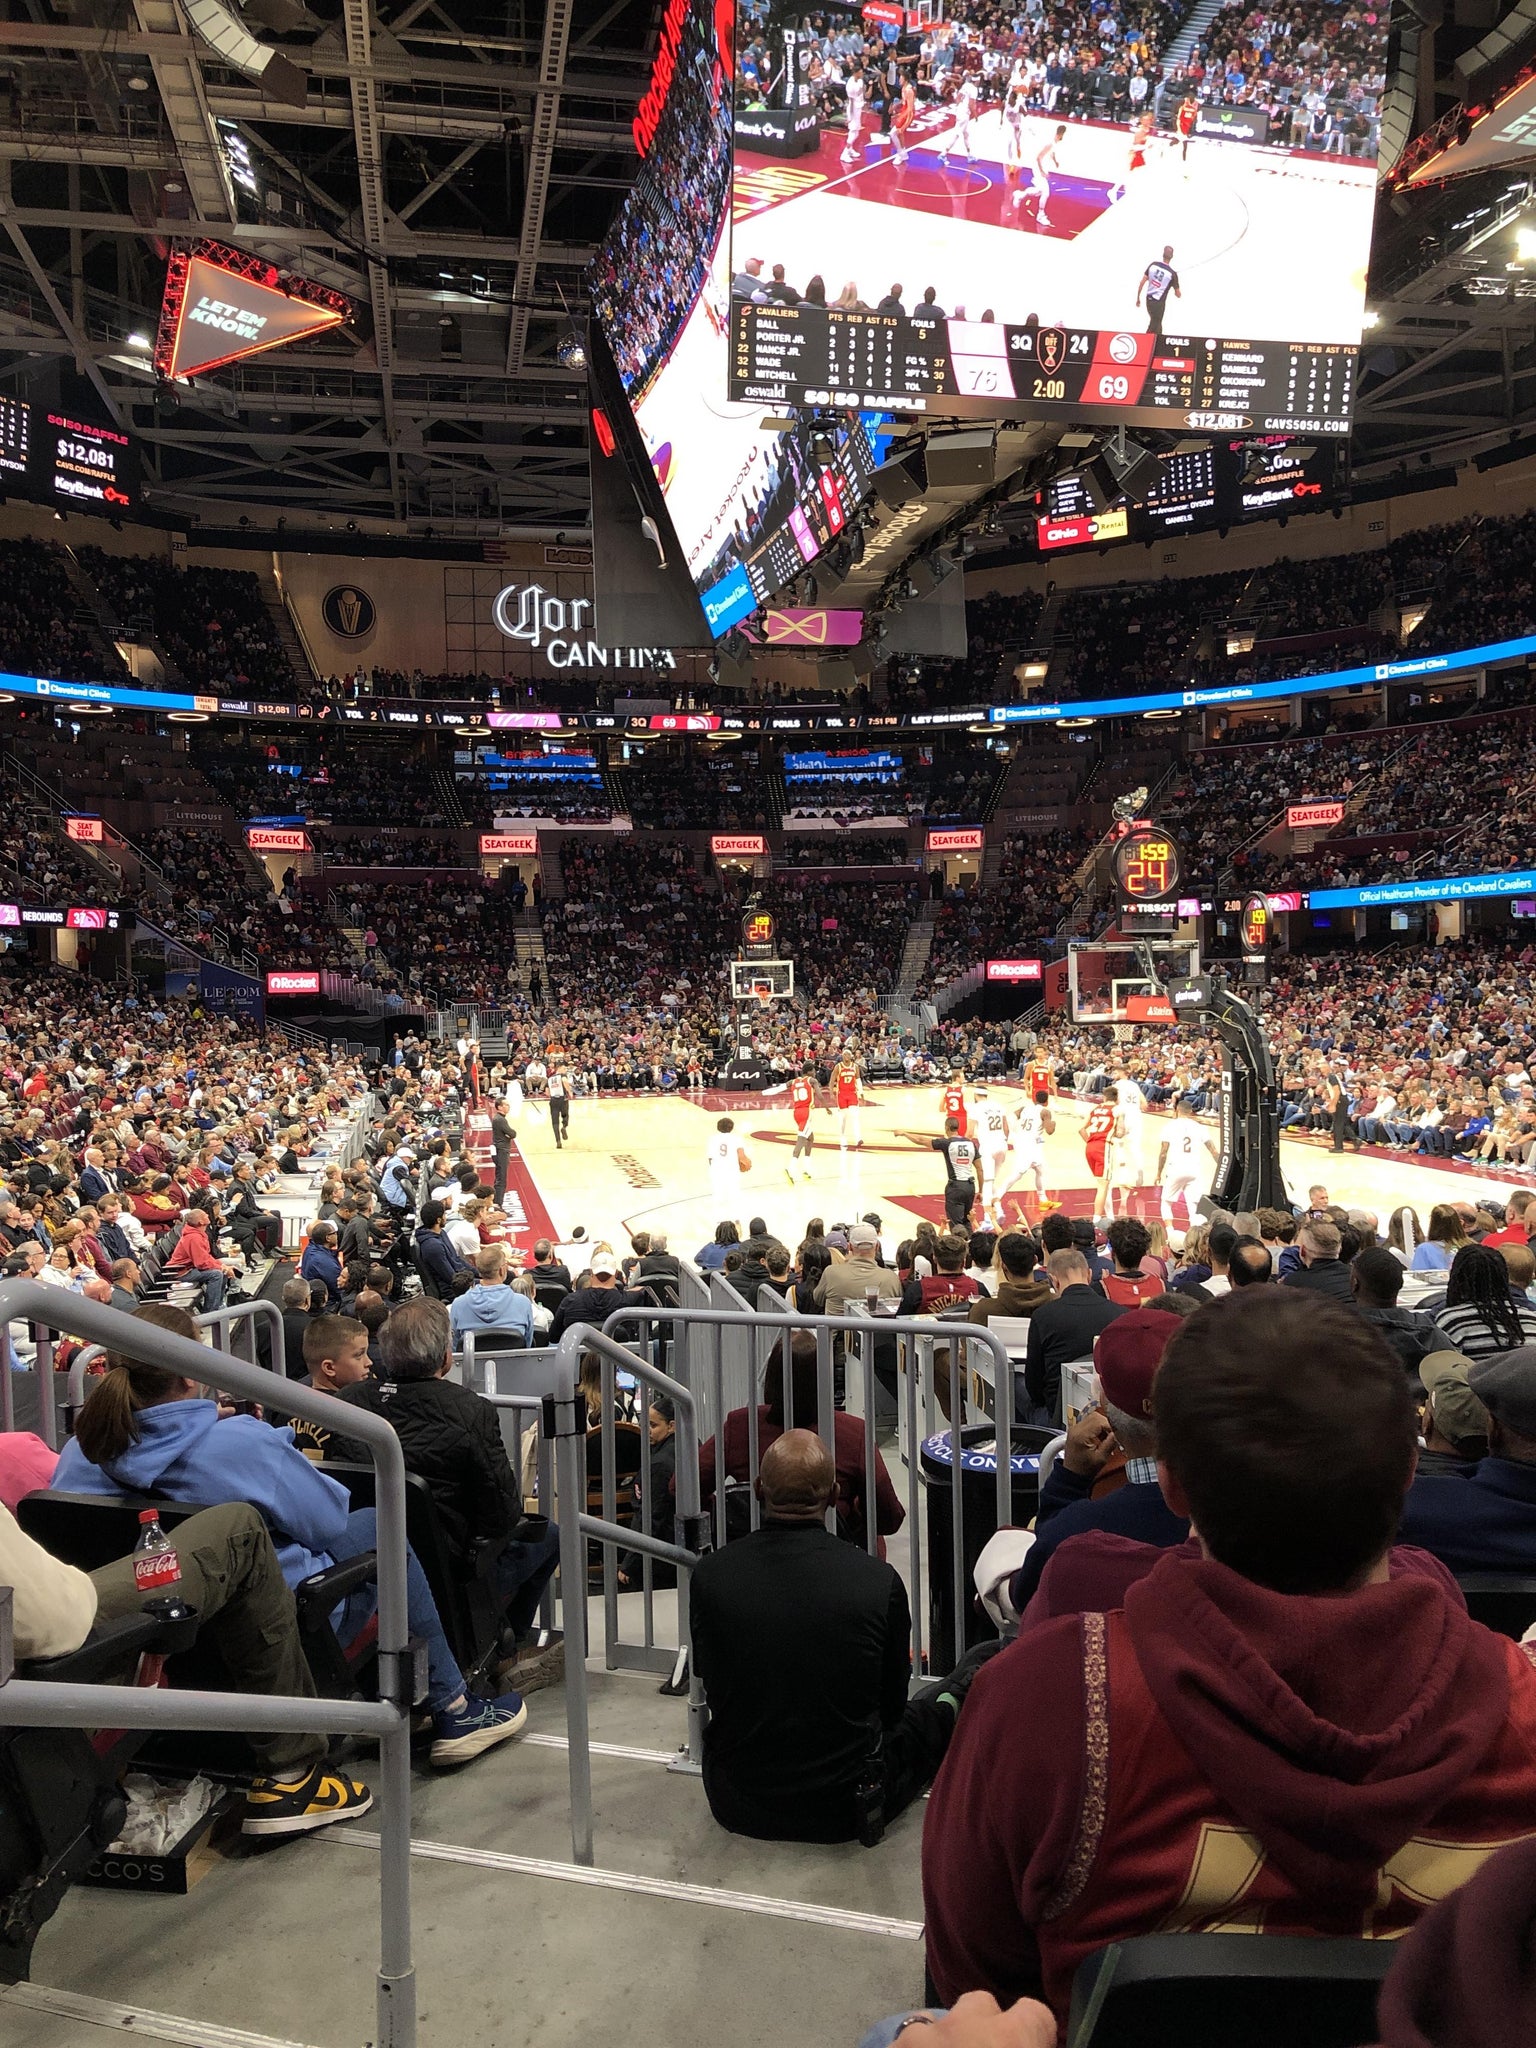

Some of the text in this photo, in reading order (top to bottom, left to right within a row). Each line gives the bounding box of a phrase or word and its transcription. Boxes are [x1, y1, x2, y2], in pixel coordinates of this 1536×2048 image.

[639, 32, 676, 141] Rocket
[198, 296, 268, 328] LET EM
[756, 307, 897, 326] CAVALIERS PTS REB AST FLS
[188, 307, 260, 341] KNOW.
[740, 319, 893, 340] 2 BALL 3 2
[911, 320, 936, 329] FOULS
[740, 331, 874, 350] 9 PORTER JR. 2 3 3
[918, 329, 926, 340] 5
[1010, 335, 1032, 351] 3Q
[1070, 335, 1089, 354] 24
[1165, 338, 1190, 346] FOULS
[1223, 341, 1250, 350] HAWKS
[1325, 346, 1340, 354] AST
[1343, 347, 1358, 355] FLS
[737, 344, 874, 363] 22 NANCE JR. 3 4 4
[1206, 352, 1213, 361] 3
[737, 356, 892, 377] 32 WADE 11 2
[933, 358, 945, 367] 37
[1206, 364, 1212, 373] 5
[737, 369, 797, 381] 45 MITCHELL
[933, 371, 944, 380] 30
[969, 370, 997, 392] 76
[1180, 375, 1192, 384] 44
[1203, 376, 1214, 384] 17
[744, 383, 787, 399] oswald
[905, 382, 943, 394] TOL 2
[1033, 379, 1065, 398] 2:00
[1099, 375, 1128, 399] 69
[1180, 388, 1191, 396] 23
[1203, 388, 1249, 398] 18 GUEYE
[863, 395, 926, 410] RAFFLE
[1154, 397, 1191, 407] TOL 2
[1201, 399, 1212, 408] 27
[1189, 412, 1243, 430] $12,081
[1264, 418, 1349, 433] CAVS5050.COM
[83, 424, 129, 445] RAFFLE
[57, 439, 114, 469] $12,081
[55, 460, 117, 482] CAVS.COM/RAFFLE
[54, 475, 105, 500] KeyBank
[713, 460, 752, 526] Rocket
[1242, 488, 1294, 506] KeyBank
[1190, 499, 1214, 509] DYSON
[865, 516, 922, 547] Rocket
[1101, 521, 1124, 530] Rental
[1047, 528, 1079, 541] Ohio
[173, 542, 187, 551] 216
[491, 583, 594, 647] Cor
[221, 702, 248, 711] oswald
[258, 704, 290, 714] $12,081
[345, 710, 377, 720] TOL 2
[390, 712, 432, 723] FOULS 5
[470, 715, 482, 725] 37
[533, 716, 546, 726] 76
[568, 717, 578, 726] 24
[868, 717, 897, 726] 7:51 PM
[911, 715, 932, 724] LET
[596, 718, 614, 726] 2:00
[631, 718, 647, 727] 3Q
[663, 718, 676, 727] 69
[748, 720, 760, 729] 44
[773, 719, 813, 728] FOULS 1
[825, 718, 856, 727] TOL 2
[176, 812, 222, 821] LITEHOUSE
[1015, 814, 1058, 822] LITEHOUSE
[1291, 808, 1339, 822] SEATGEEK
[252, 833, 301, 846] SEATGEEK
[484, 839, 533, 849] SEATGEEK
[715, 840, 759, 850] SEATGEEK
[932, 834, 977, 845] SEATGEEK
[1140, 843, 1168, 861] 1:59
[1127, 861, 1164, 891] 24
[1360, 878, 1533, 902] Official Healthcare Provider of the Cleveland Cavaliers
[1137, 903, 1177, 912] TISSOT
[1225, 901, 1241, 911] 2:00
[22, 911, 63, 922] REBOUNDS
[73, 912, 86, 924] 37
[749, 924, 768, 939] 24
[1248, 925, 1263, 944] 24
[280, 977, 317, 989] Rocket
[949, 1097, 960, 1111] 3
[988, 1115, 1002, 1131] 22
[1021, 1118, 1033, 1131] 45
[1090, 1116, 1111, 1132] 27
[1183, 1136, 1191, 1153] 2
[1215, 1093, 1231, 1189] Cleveland Clinic
[720, 1144, 728, 1157] 9
[958, 1144, 969, 1157] 85
[927, 1294, 964, 1314] MITCHE
[136, 1553, 177, 1580] Coca-Cola
